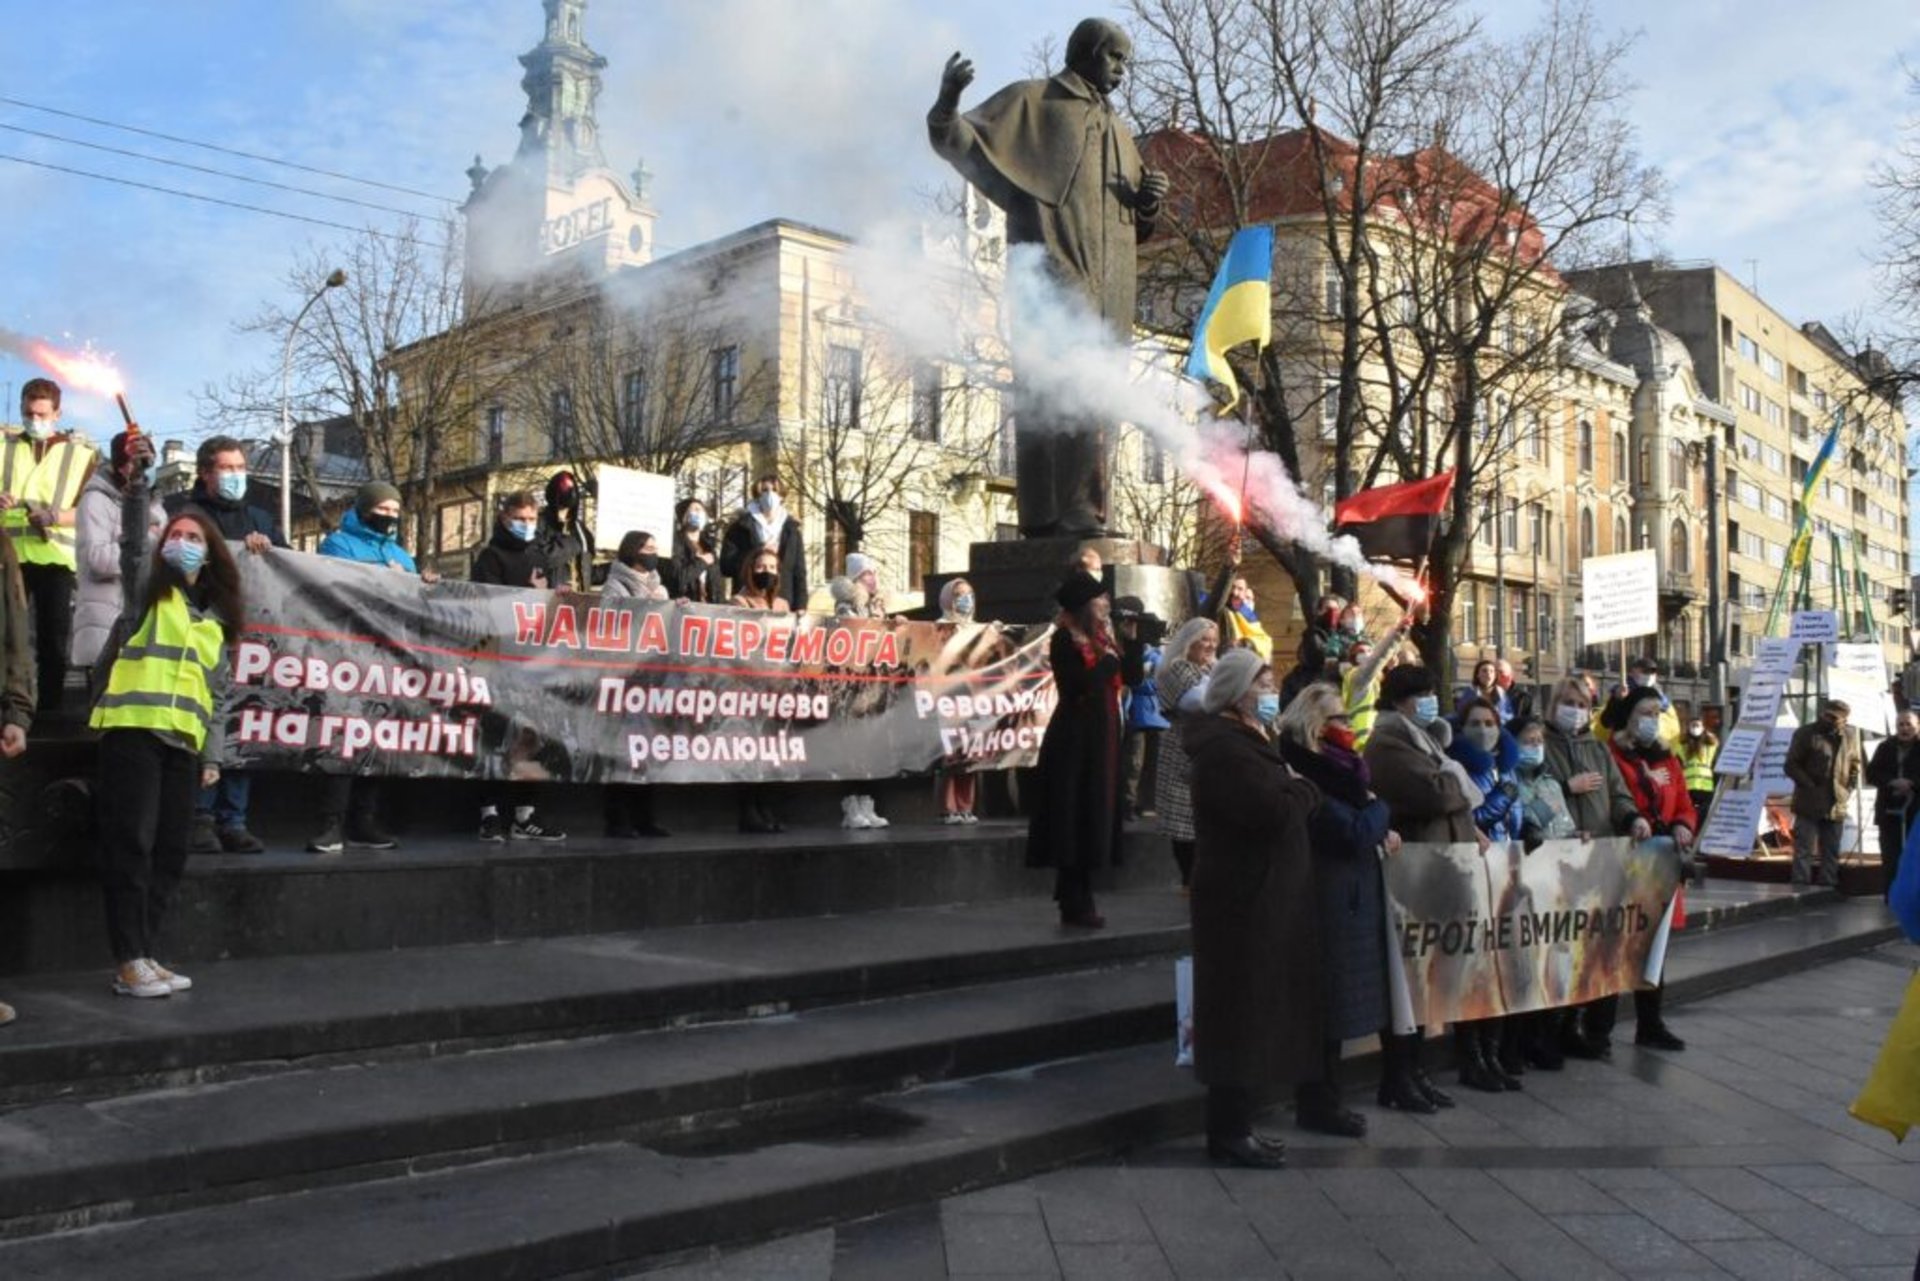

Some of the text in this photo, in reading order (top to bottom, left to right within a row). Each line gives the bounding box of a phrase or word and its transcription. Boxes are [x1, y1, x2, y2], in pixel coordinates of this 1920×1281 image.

[513, 601, 899, 668] НАША ПЕРЕМОГА
[235, 642, 492, 707] Революція
[597, 677, 829, 723] Помаранчева
[240, 709, 477, 758] на граніті
[628, 729, 807, 768] революція
[1396, 902, 1648, 957] ЕРОЇ НЕ ВМИРАЮТЬ
